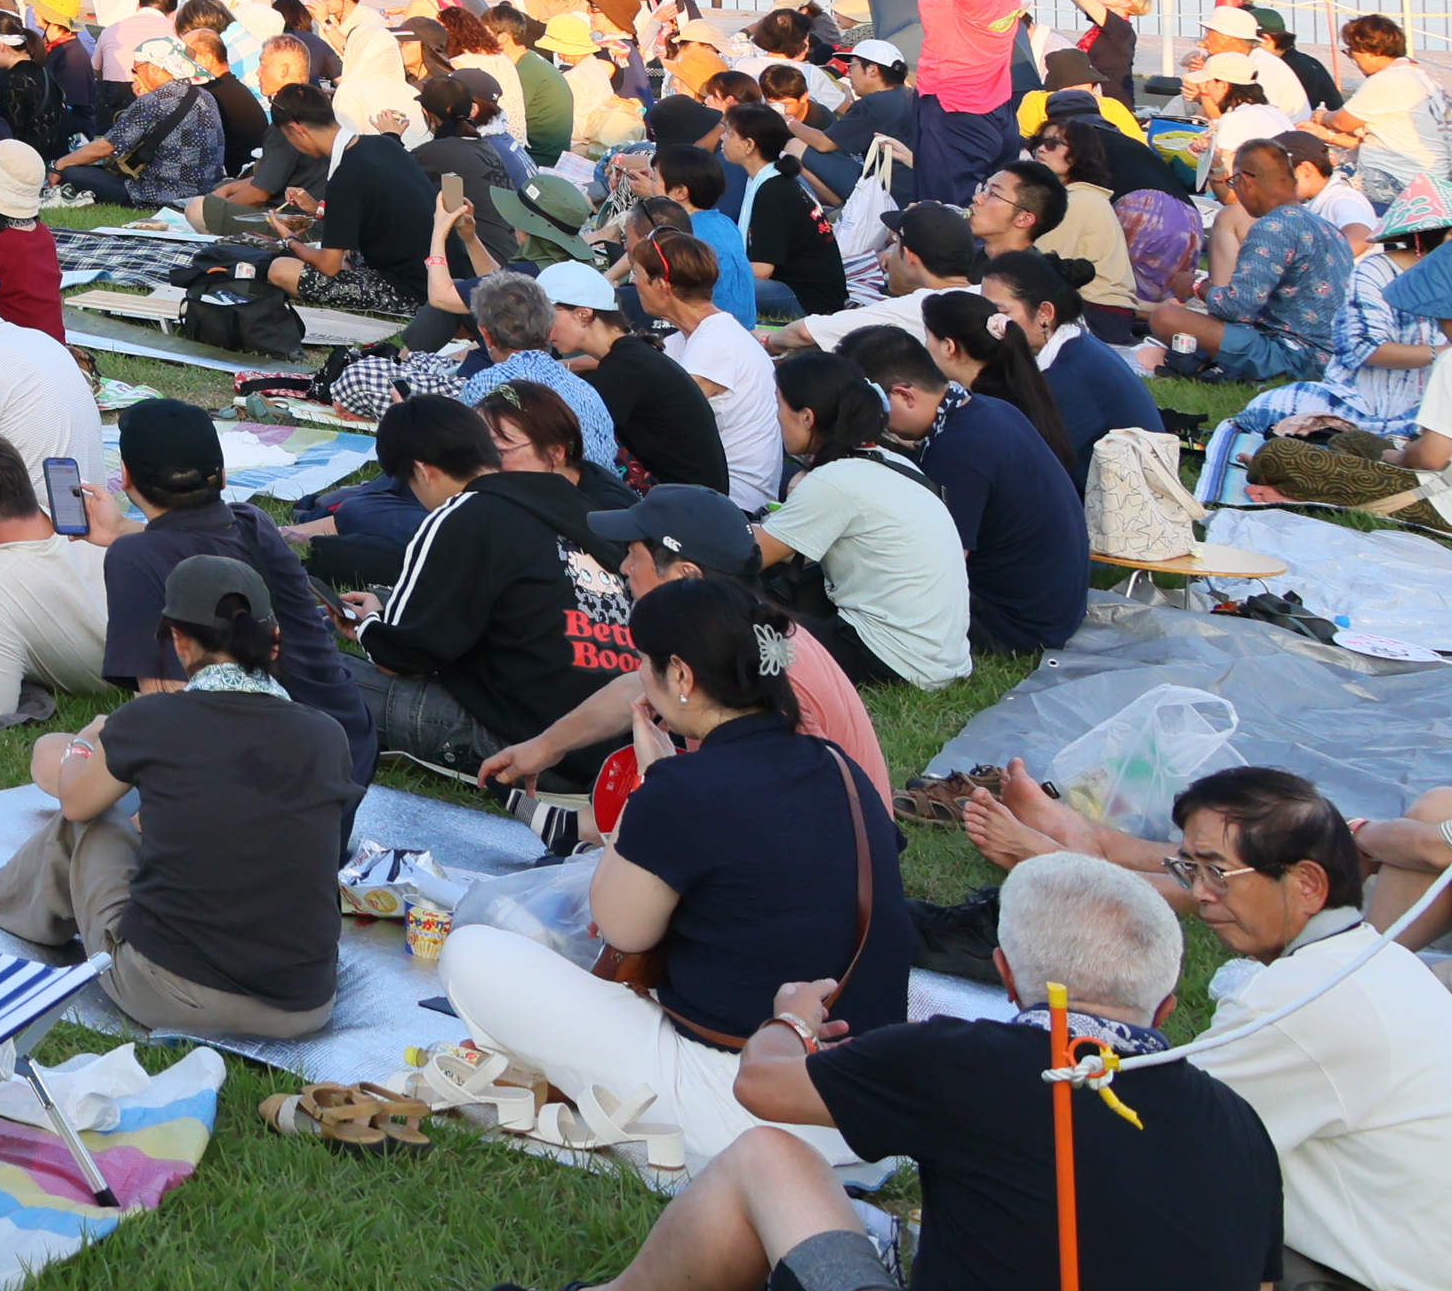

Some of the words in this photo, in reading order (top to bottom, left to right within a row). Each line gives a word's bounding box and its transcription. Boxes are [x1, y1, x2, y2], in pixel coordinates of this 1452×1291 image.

[564, 609, 637, 650] Bett
[407, 911, 453, 933] じゃがりこ
